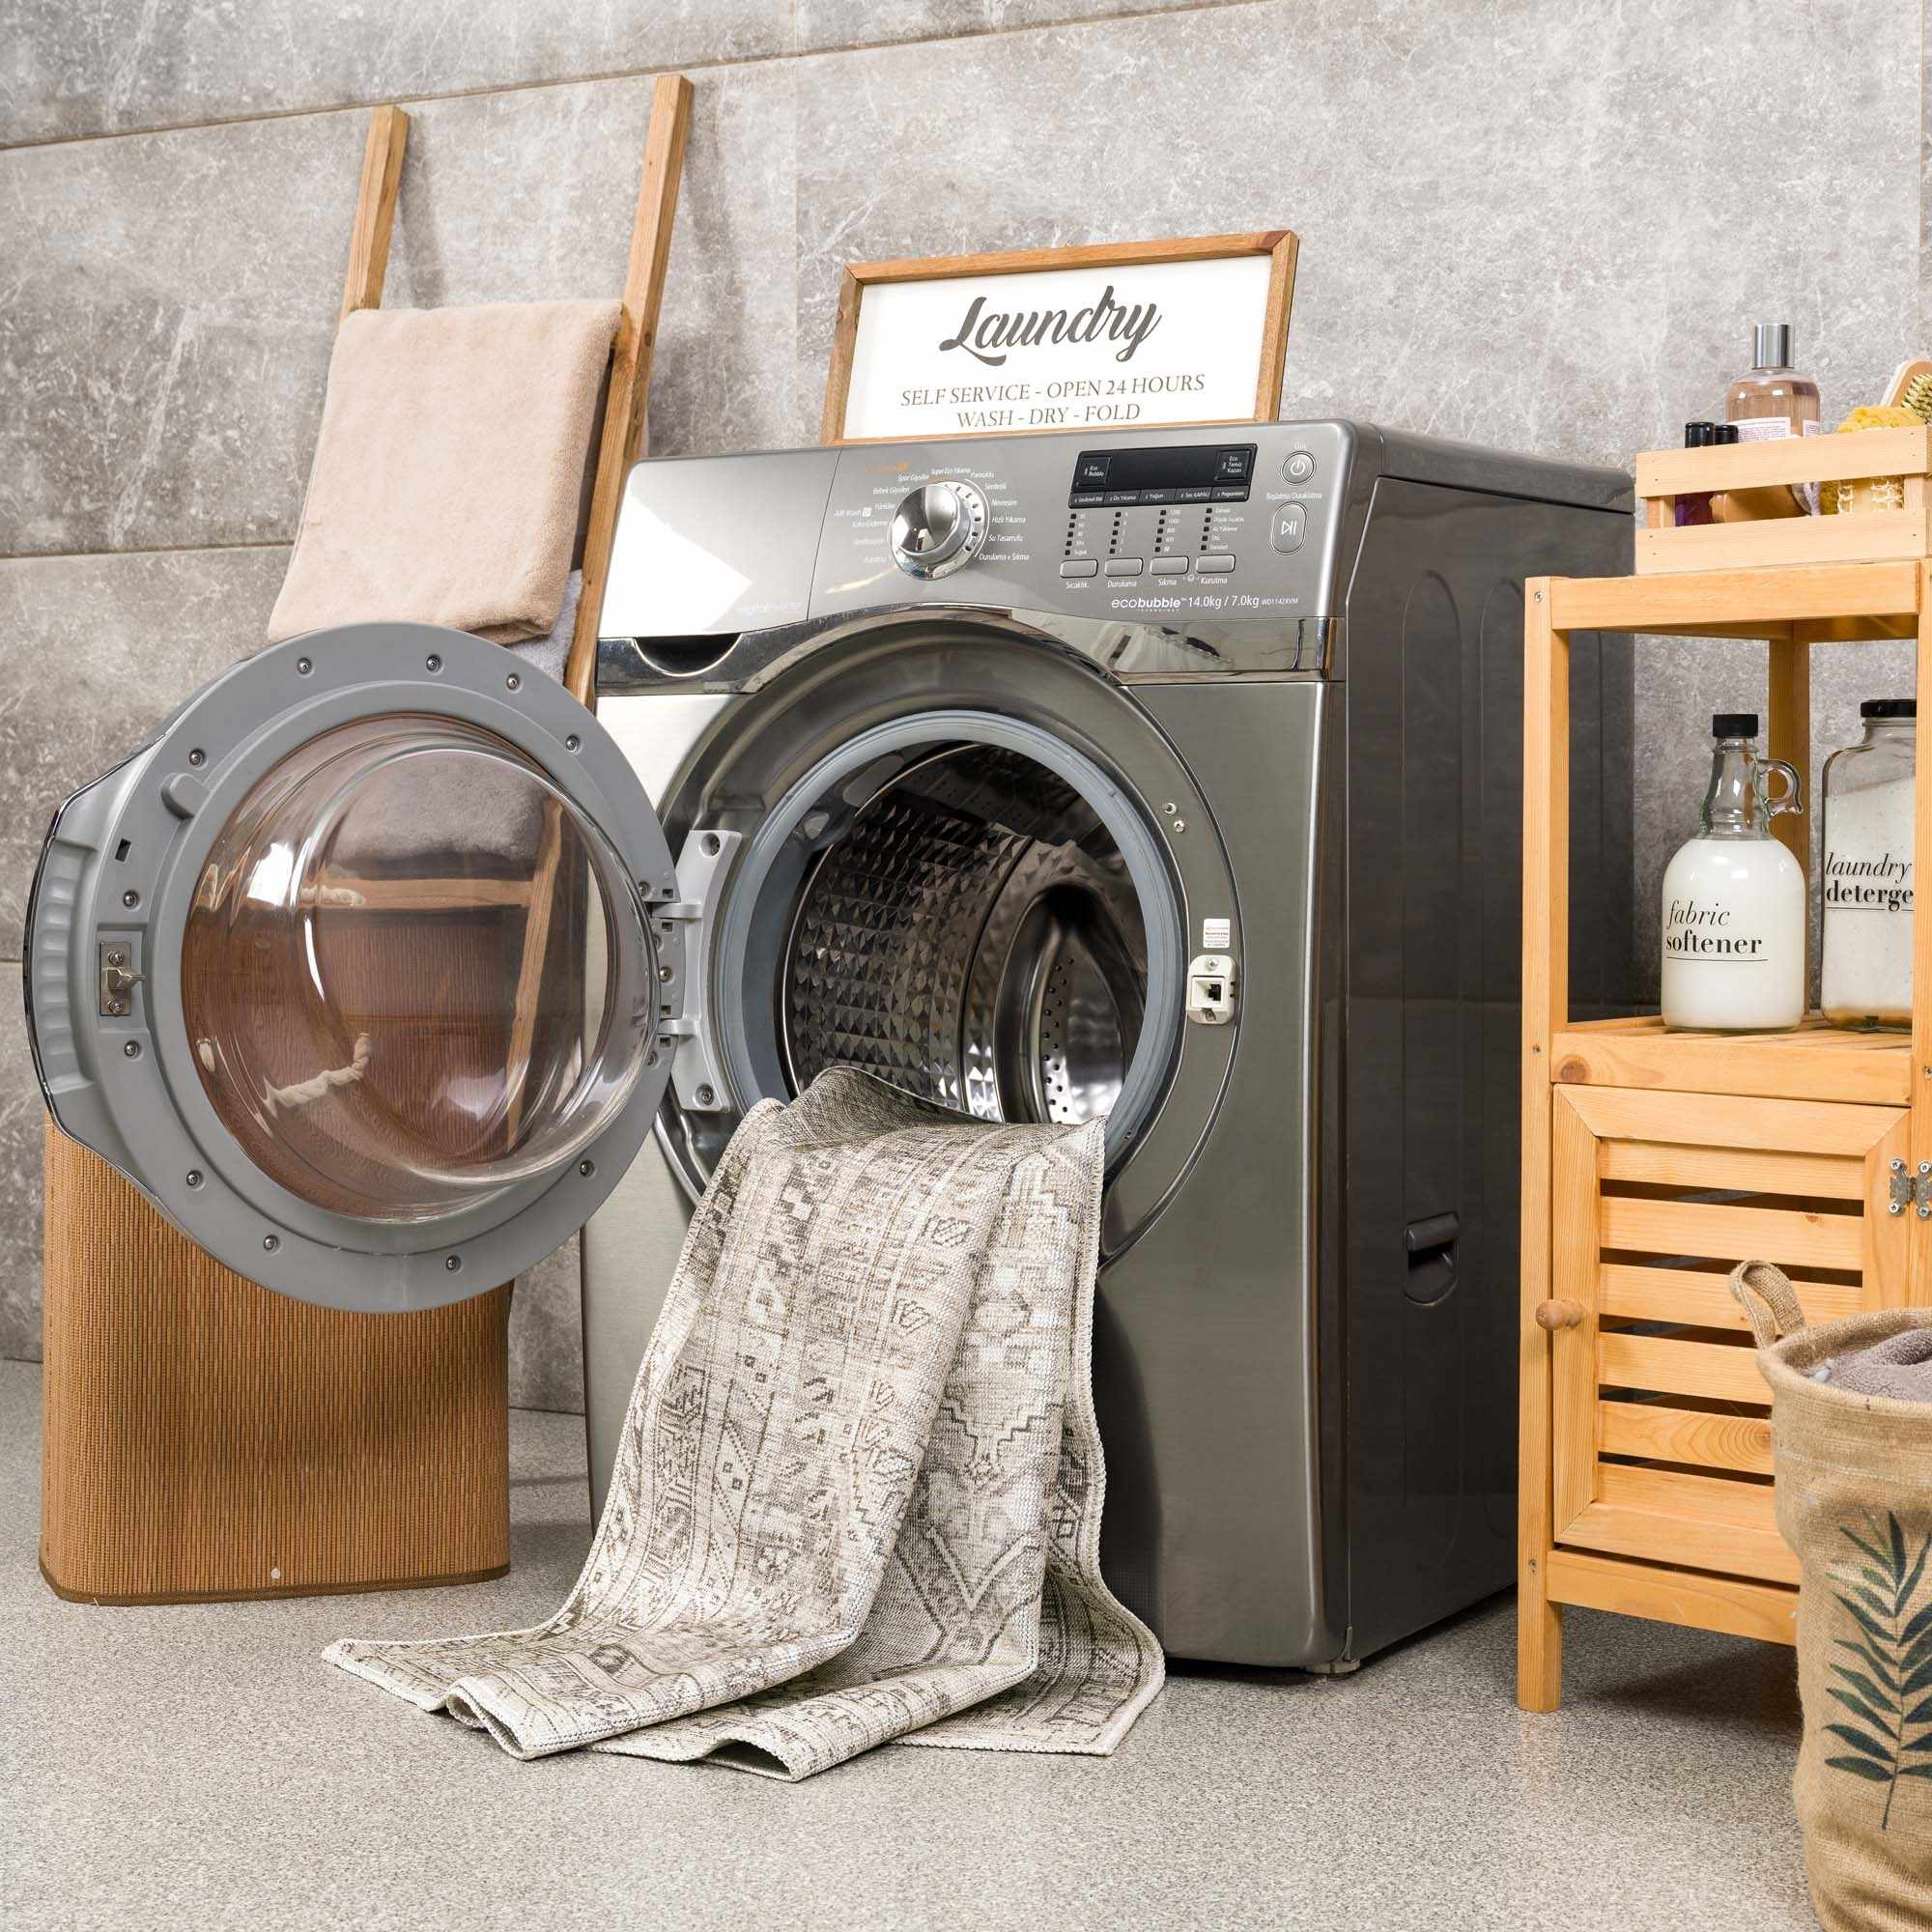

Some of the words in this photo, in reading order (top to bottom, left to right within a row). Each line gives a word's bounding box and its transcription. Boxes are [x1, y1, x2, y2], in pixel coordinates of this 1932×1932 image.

[939, 285, 1162, 366] Laundry
[900, 388, 947, 406] SELF
[950, 384, 1031, 404] SERVICE
[1046, 381, 1101, 398] OPEN
[1105, 380, 1126, 395] 24
[1131, 374, 1206, 394] HOURS
[957, 410, 1013, 428] WASH
[1029, 407, 1068, 424] DRY
[1085, 404, 1140, 421] FOLD
[1188, 596, 1222, 610] 14.0kg
[1232, 595, 1260, 609] 7.0kg
[1825, 851, 1913, 884] laundry
[1826, 880, 1914, 912] deterge
[1666, 900, 1730, 930] fabric
[1666, 929, 1762, 954] softener
